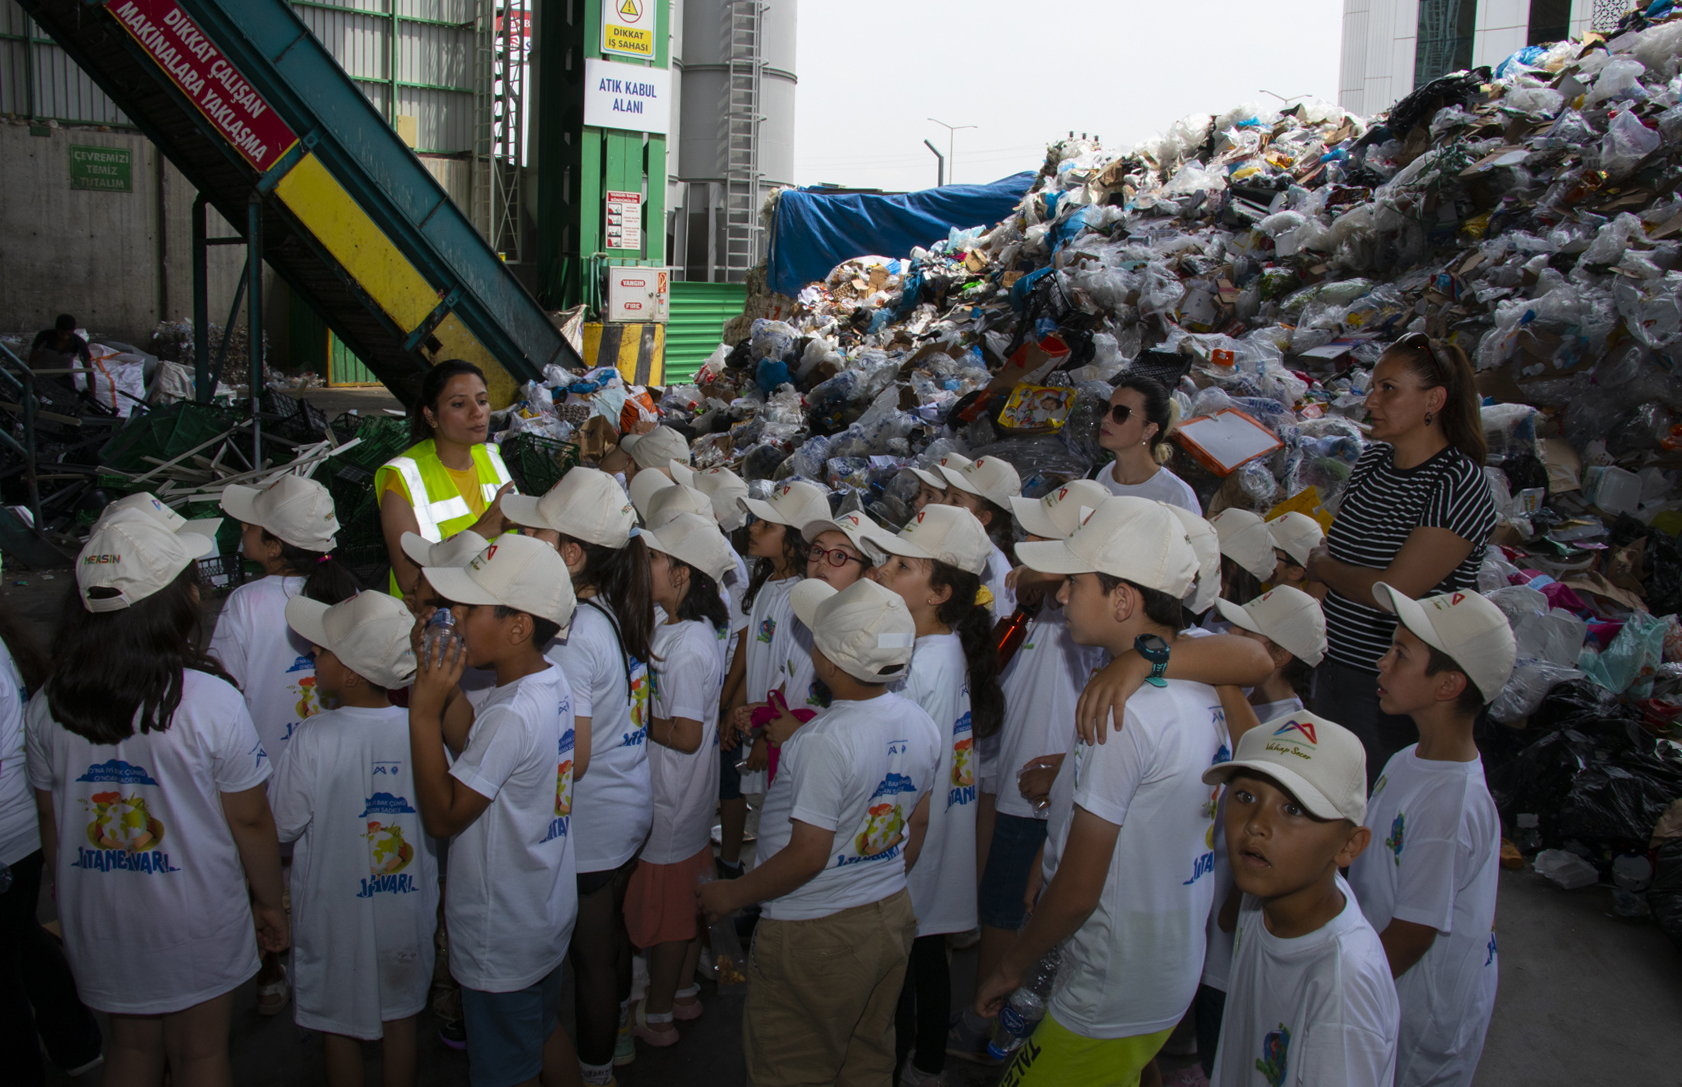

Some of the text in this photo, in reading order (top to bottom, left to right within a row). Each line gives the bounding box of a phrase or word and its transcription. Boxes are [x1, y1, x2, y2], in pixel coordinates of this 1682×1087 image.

[613, 27, 644, 40] DİKKAT
[608, 36, 648, 52] İŞ SAHASI
[163, 7, 267, 119] DİKKAT ÇALIŞAN
[116, 1, 268, 163] MAKİNALARA YAKLAŞMA
[599, 78, 657, 98] ATIK KABUL
[612, 98, 643, 114] ALANI
[86, 164, 118, 175] TEMİZ
[80, 177, 124, 188] TUTALIM
